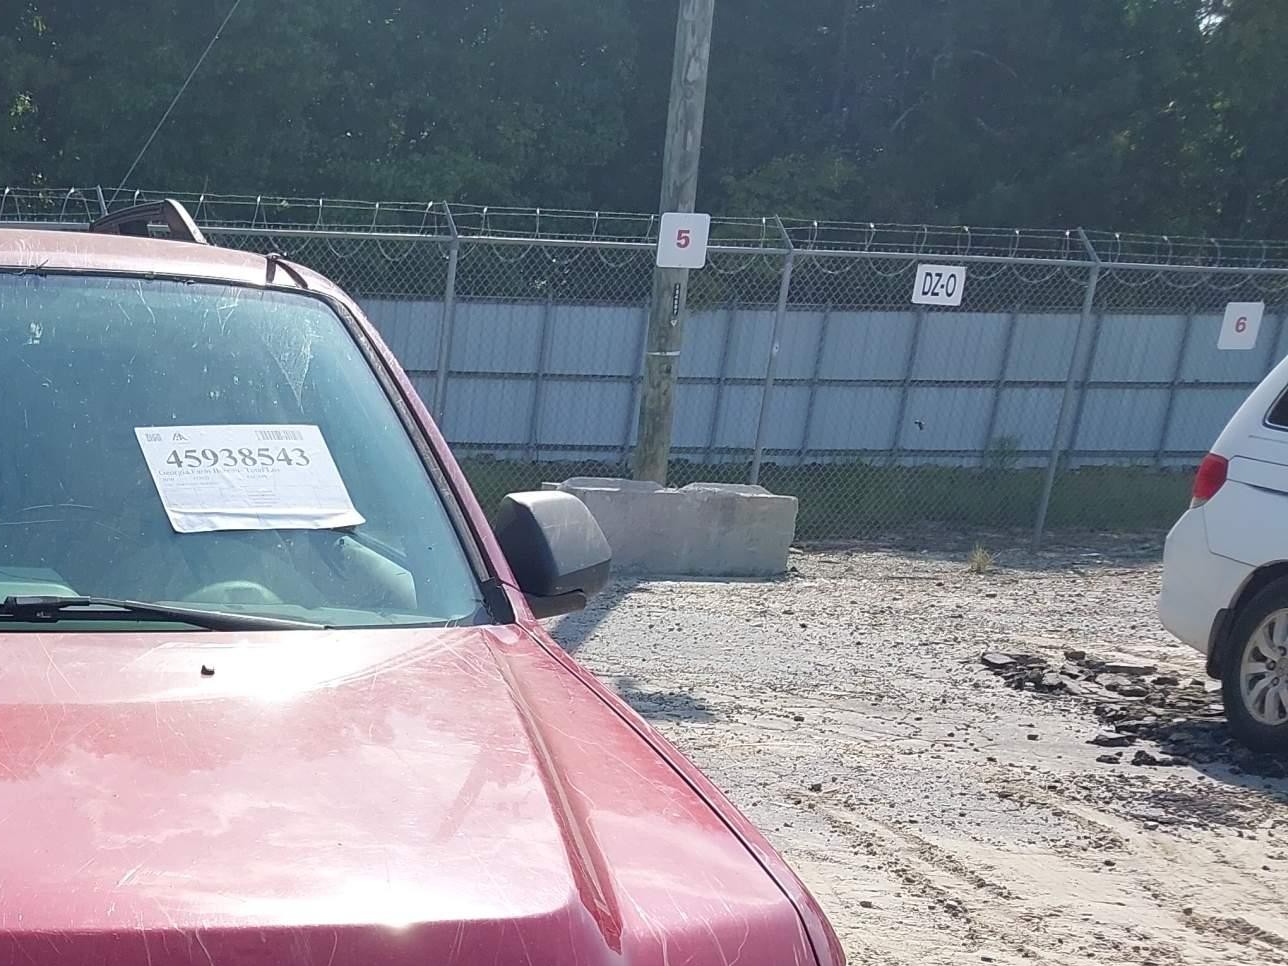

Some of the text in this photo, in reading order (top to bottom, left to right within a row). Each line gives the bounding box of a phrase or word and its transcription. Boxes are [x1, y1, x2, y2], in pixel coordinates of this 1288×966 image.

[676, 229, 690, 248] 5
[1235, 316, 1247, 333] 6
[165, 447, 311, 468] 45938543
